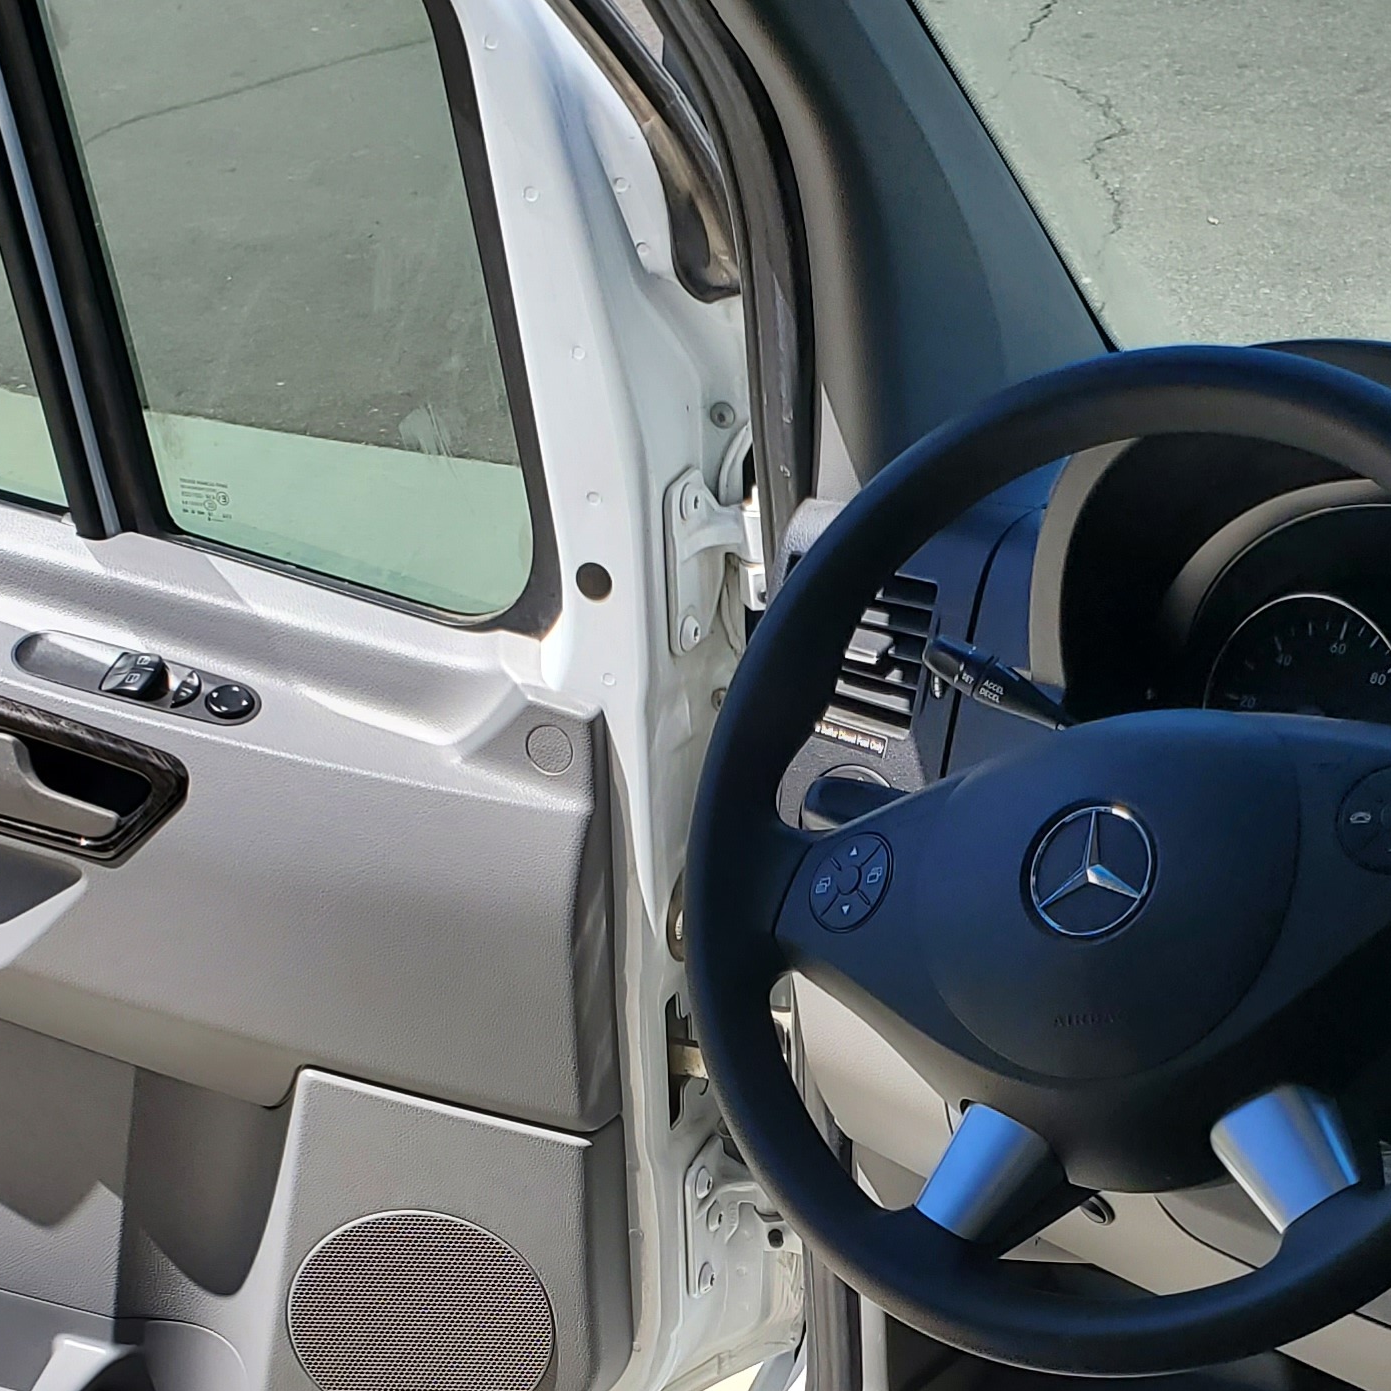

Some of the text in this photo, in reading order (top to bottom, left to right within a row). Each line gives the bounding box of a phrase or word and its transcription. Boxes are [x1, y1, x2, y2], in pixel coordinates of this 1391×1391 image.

[1329, 642, 1347, 655] 60
[1369, 671, 1387, 686] 80
[979, 687, 1001, 703] DECEL
[982, 679, 1005, 696] ACCEL
[1240, 695, 1258, 709] 20
[869, 738, 885, 755] Only
